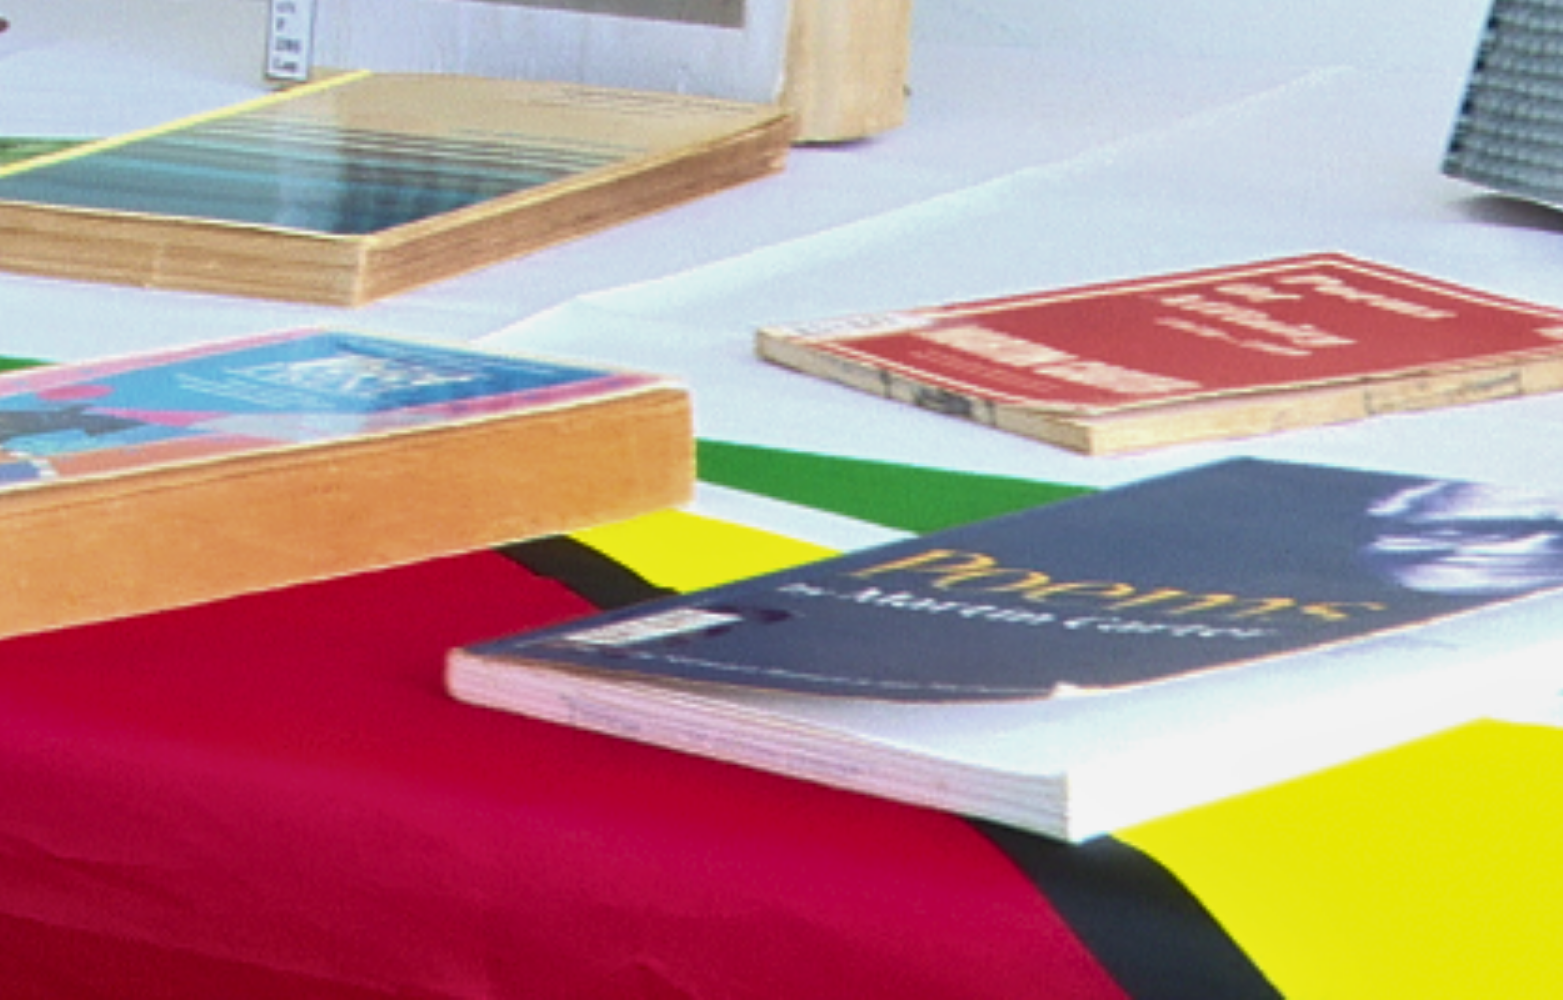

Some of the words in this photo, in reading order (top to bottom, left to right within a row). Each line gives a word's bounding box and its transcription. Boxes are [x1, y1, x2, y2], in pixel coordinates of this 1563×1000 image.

[849, 548, 1389, 621] Poems
[852, 585, 1055, 626] Martin
[1060, 614, 1279, 639] Carter
